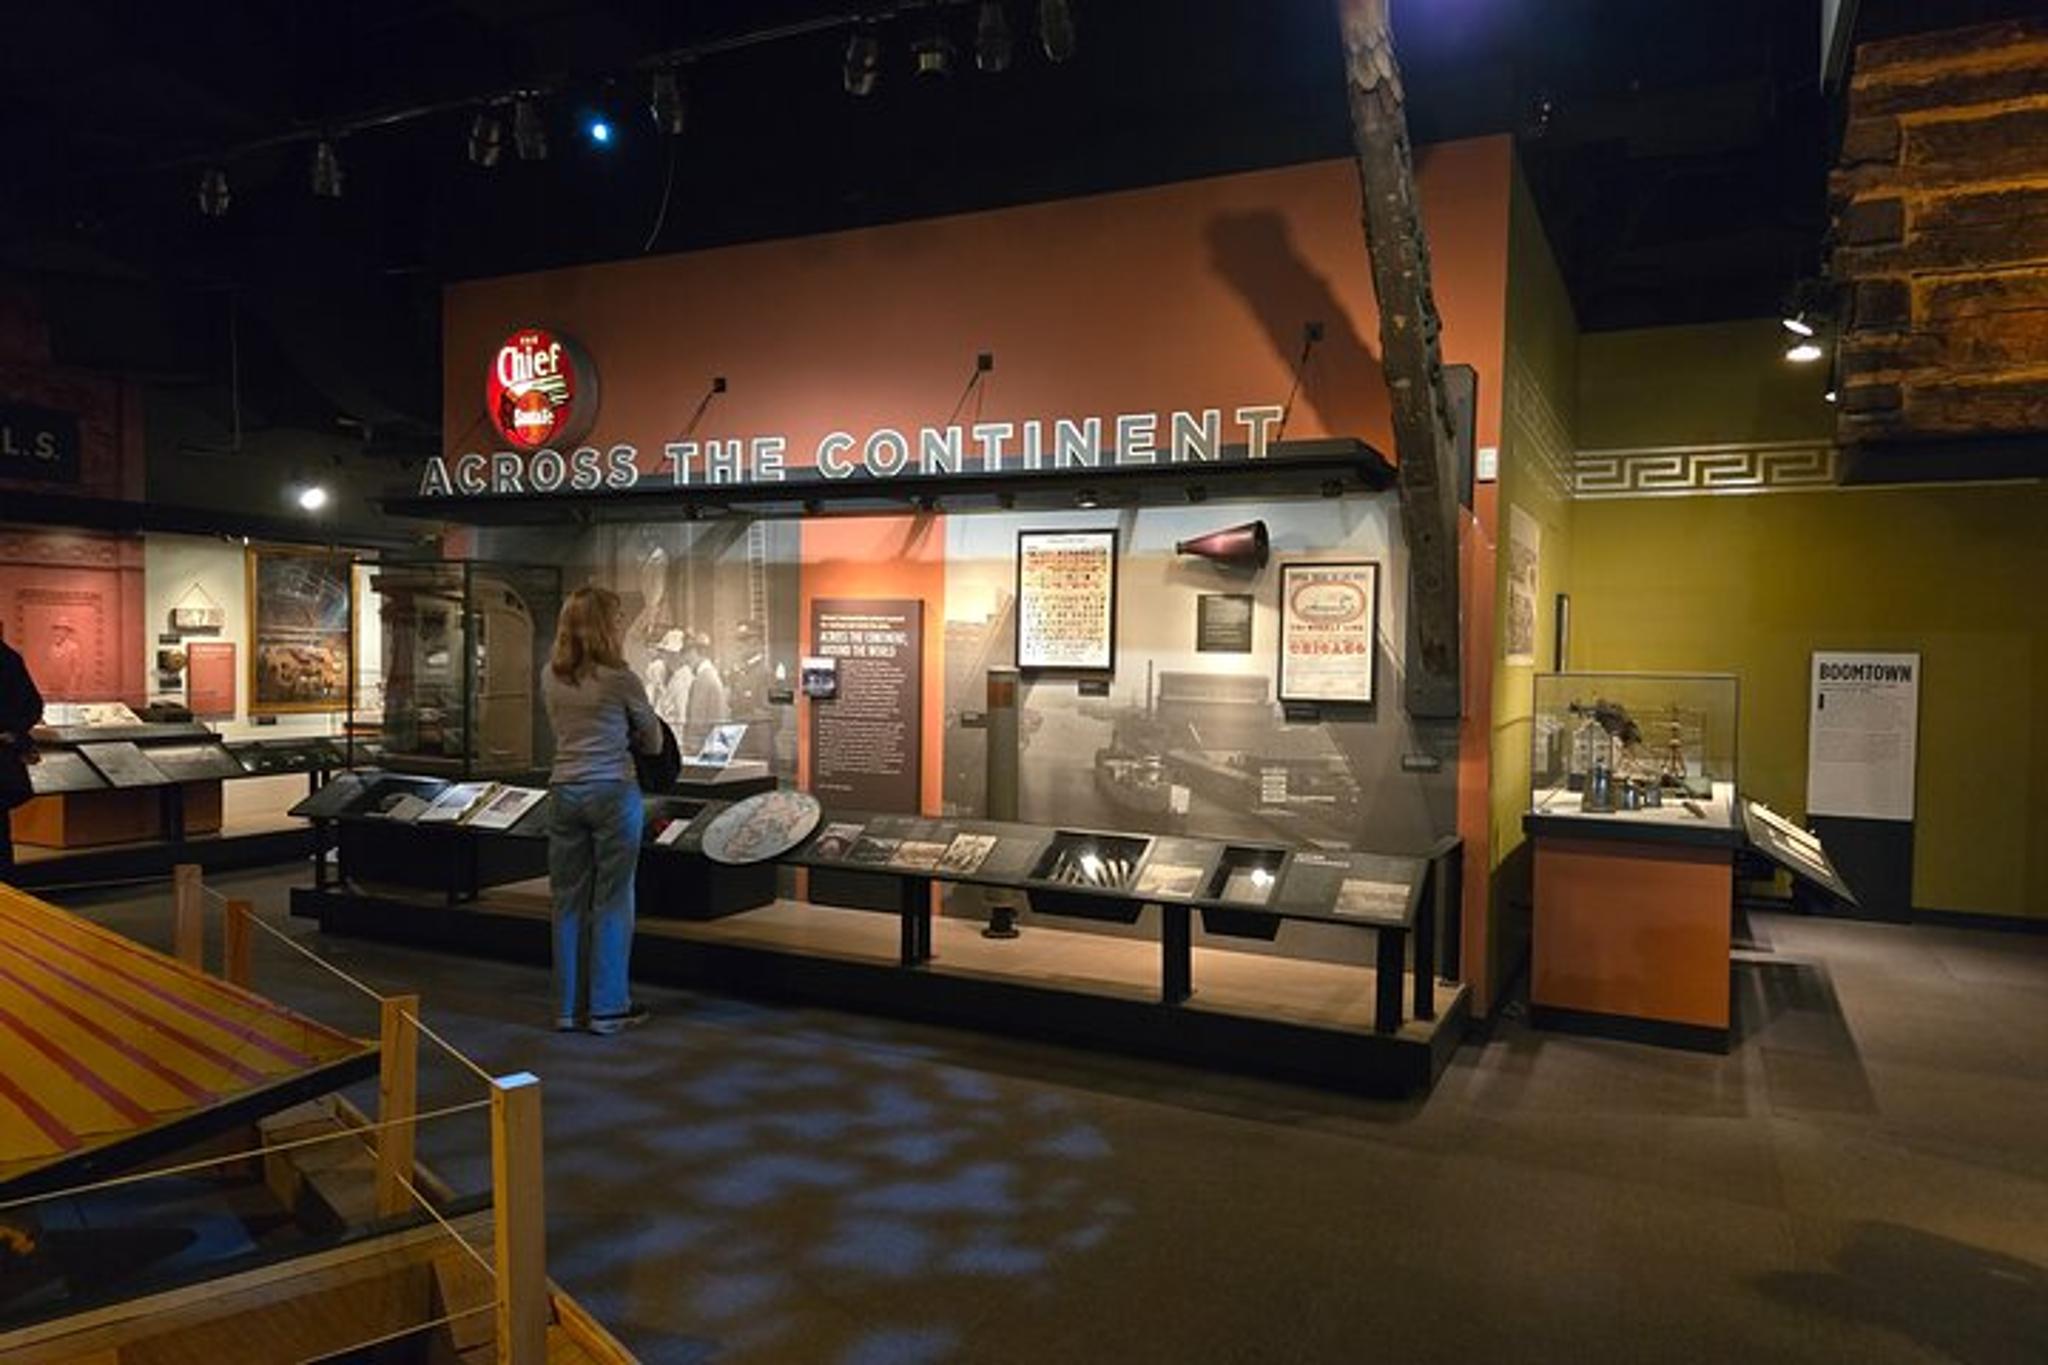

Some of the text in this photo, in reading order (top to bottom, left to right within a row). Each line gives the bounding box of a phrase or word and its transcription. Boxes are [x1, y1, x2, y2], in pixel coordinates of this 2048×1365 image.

[497, 341, 561, 388] Chief
[420, 406, 1283, 496] ACROSS THE CONTINENT
[1820, 662, 1912, 682] BOOMTOWN
